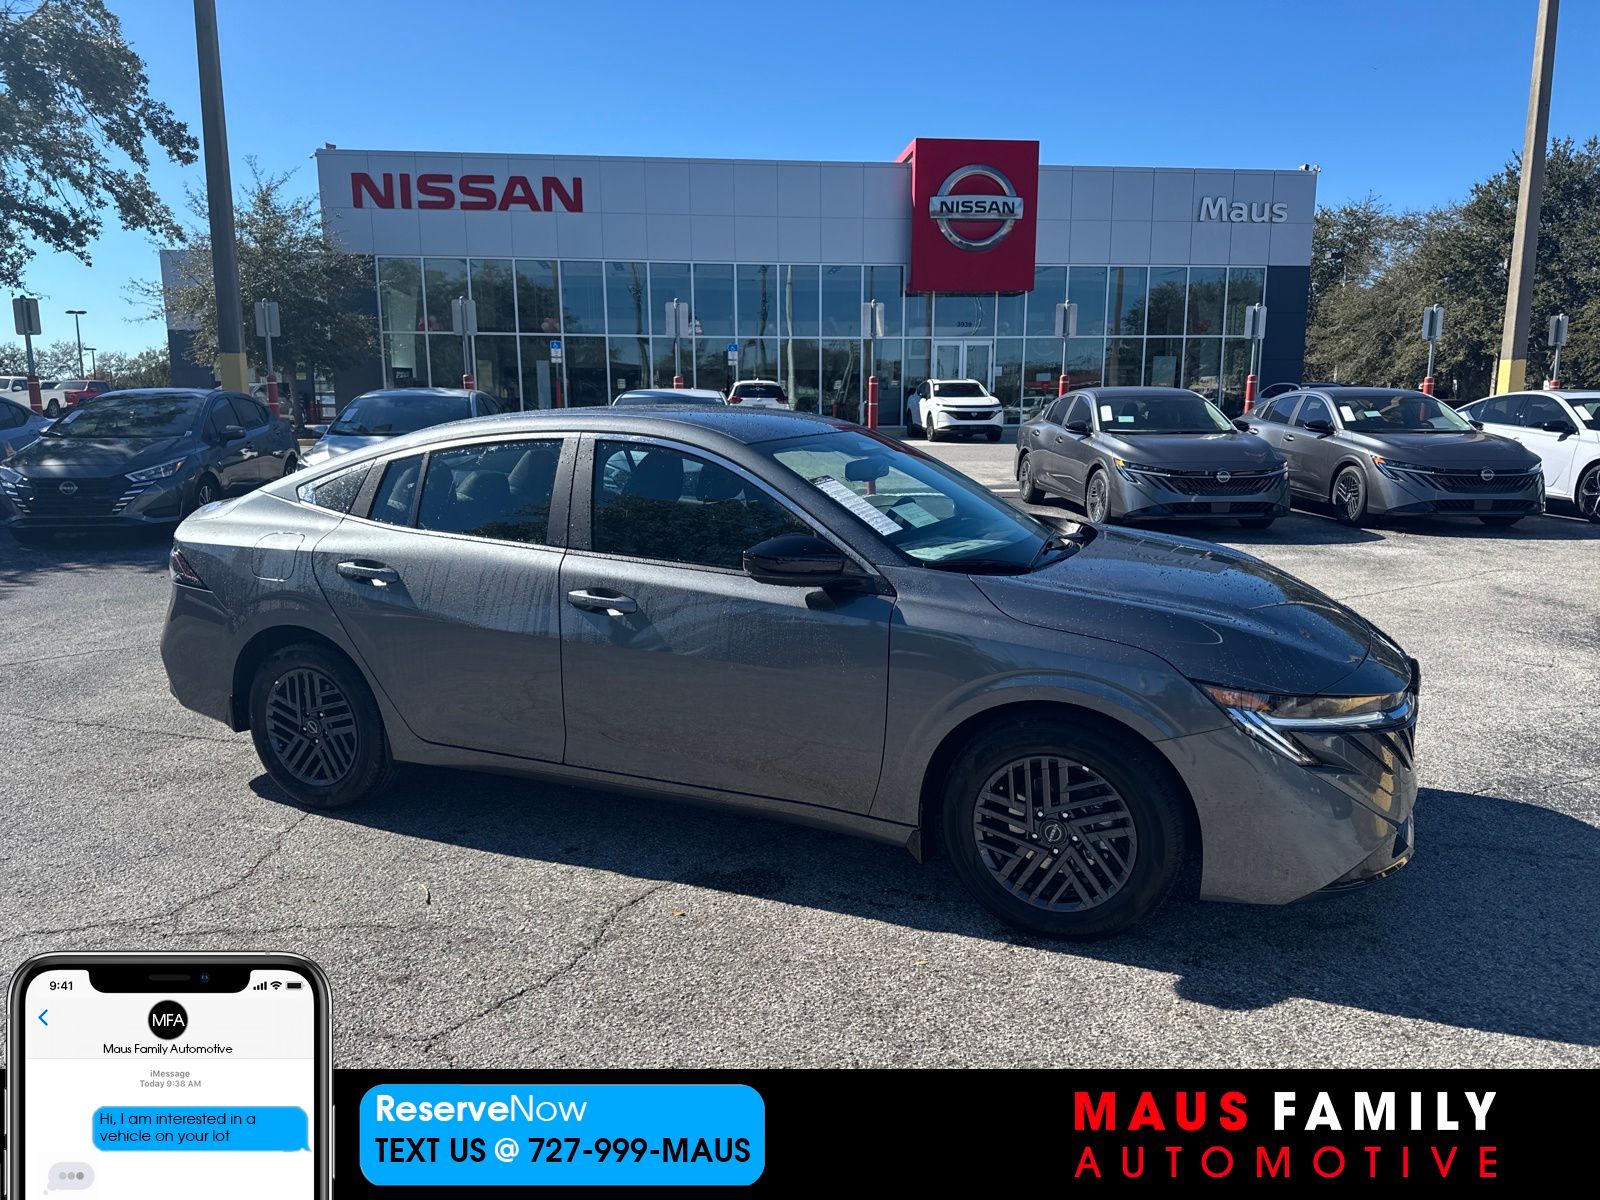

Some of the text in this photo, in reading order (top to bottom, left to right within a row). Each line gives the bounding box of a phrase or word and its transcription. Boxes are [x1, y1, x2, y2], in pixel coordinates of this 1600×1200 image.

[350, 171, 584, 213] NISSAN
[939, 199, 1016, 215] NISSAN
[1199, 196, 1289, 223] Maus
